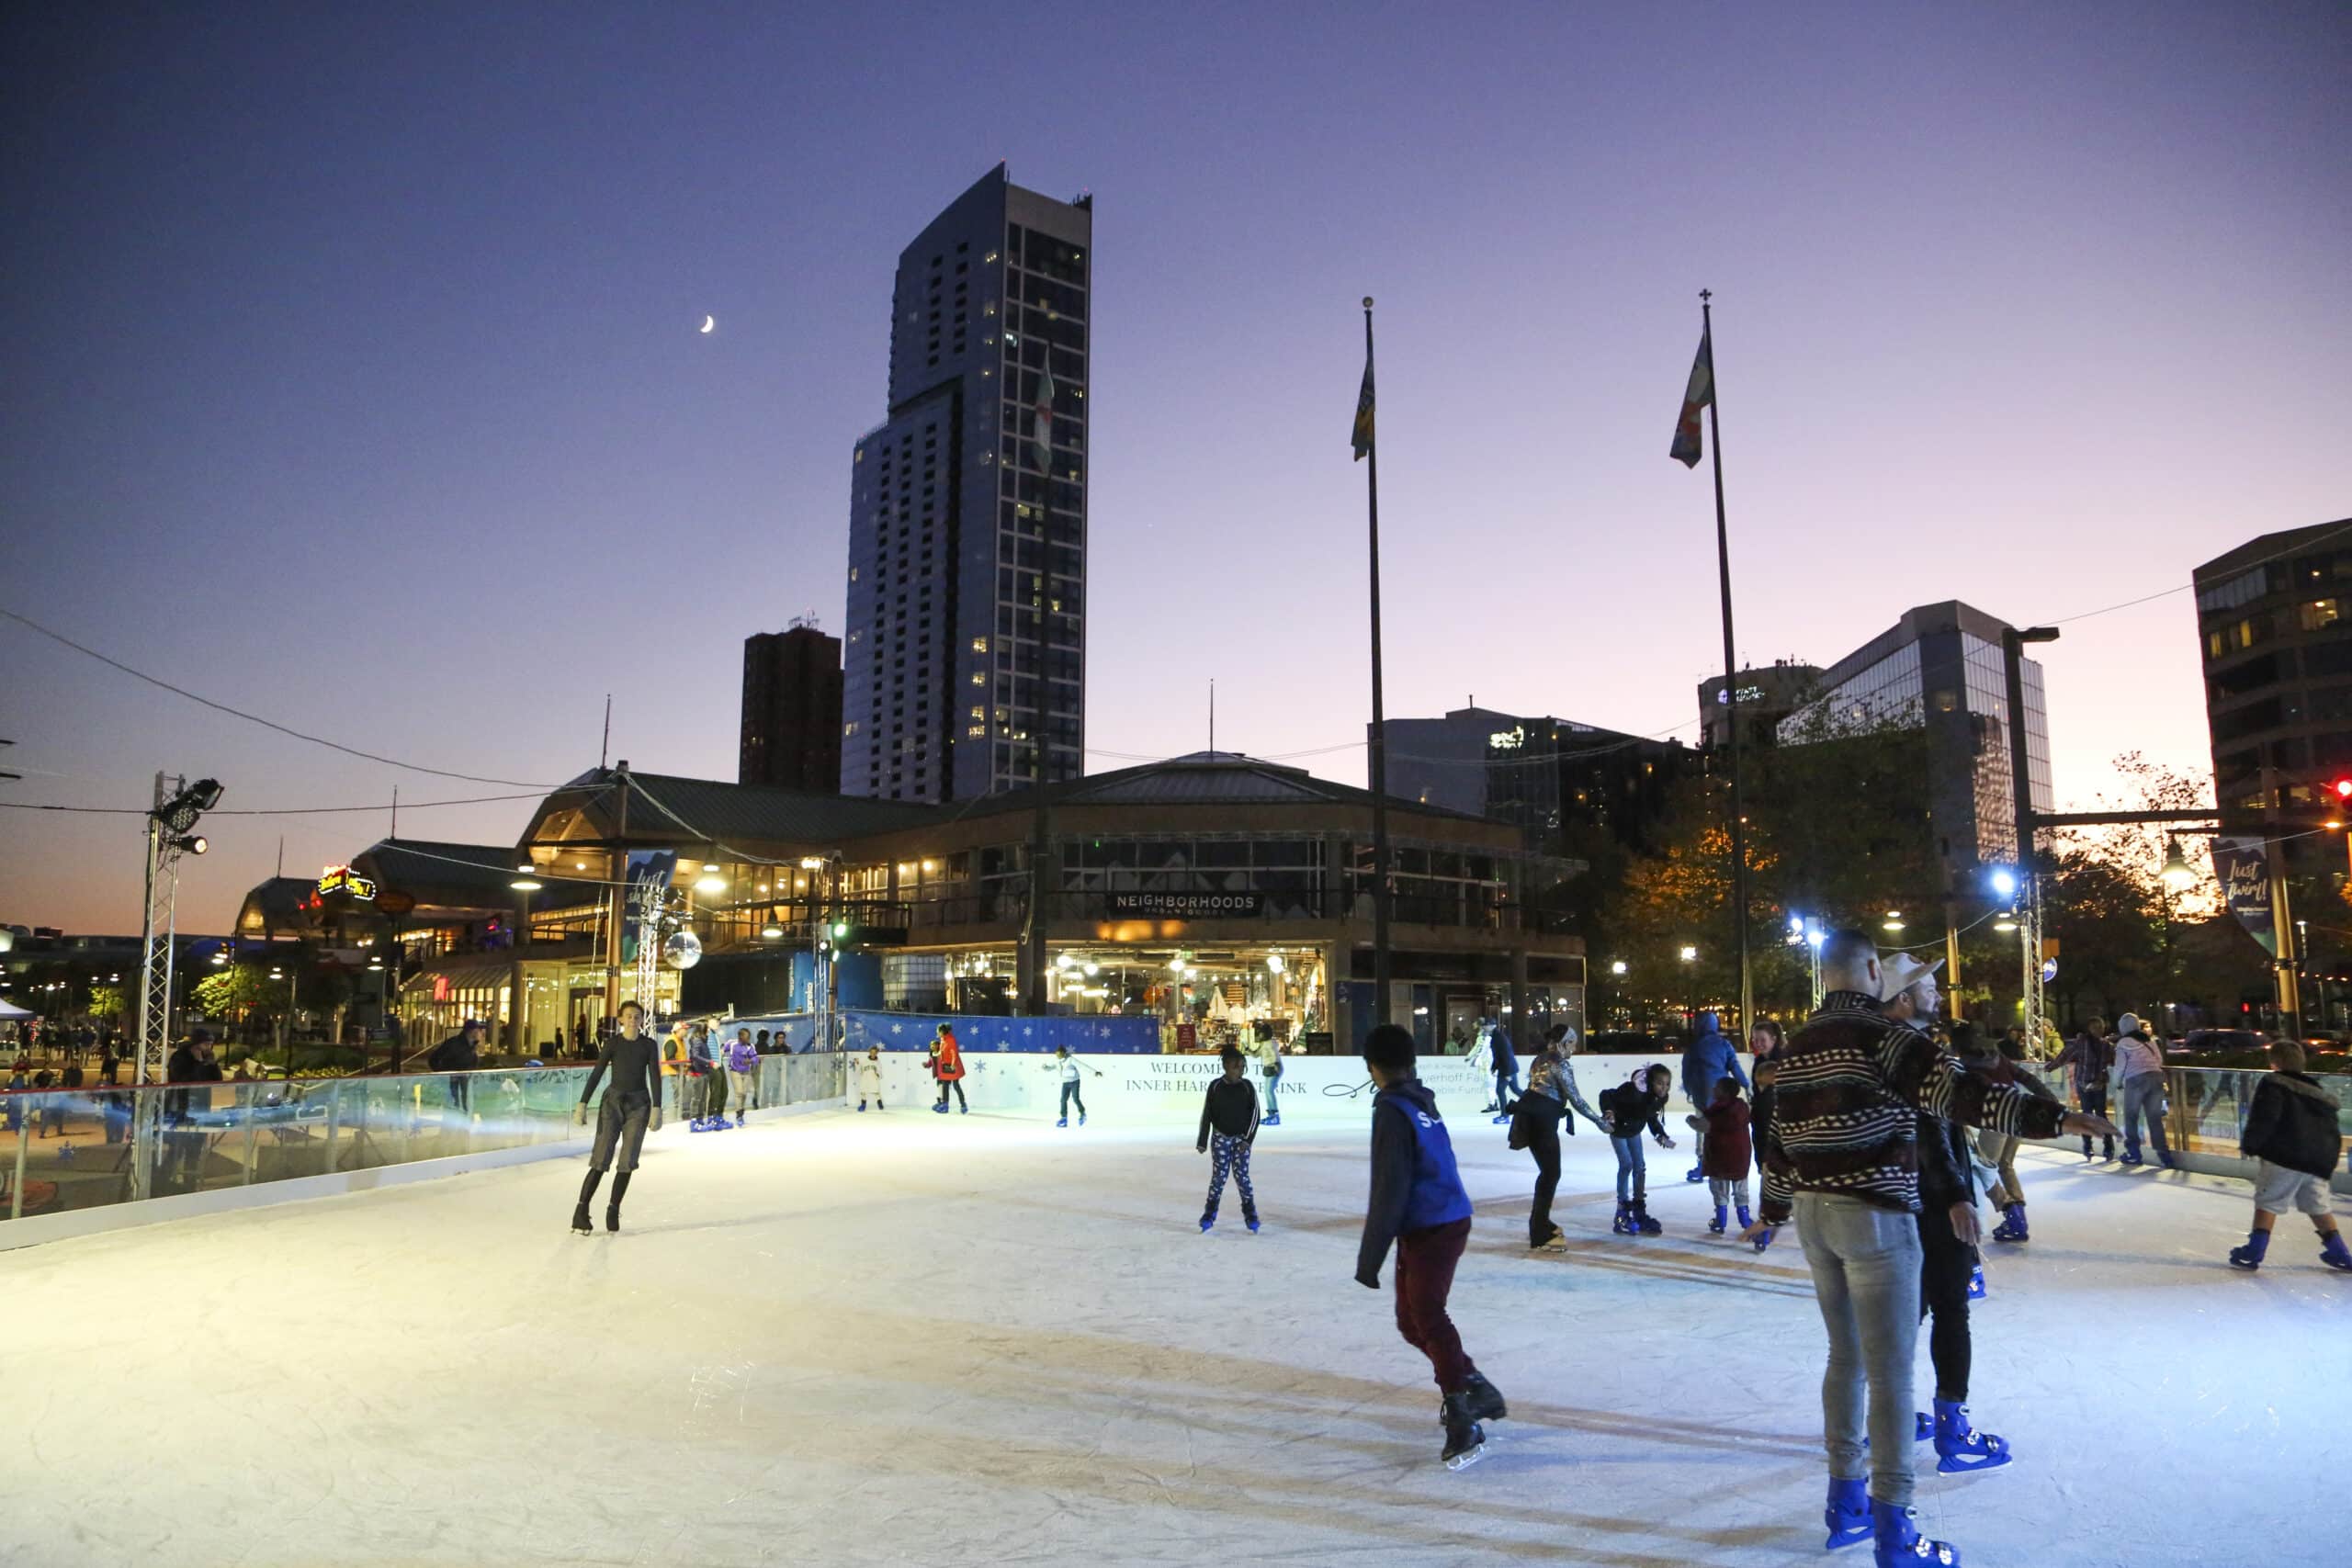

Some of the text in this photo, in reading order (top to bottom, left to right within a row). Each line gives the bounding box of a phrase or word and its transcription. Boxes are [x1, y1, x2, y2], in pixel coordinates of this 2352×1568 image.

[2227, 859, 2262, 882] Just
[2227, 878, 2267, 901] twirl!
[1117, 894, 1255, 908] NEIGHBORHOODS
[1151, 1062, 1223, 1075] WELCOME
[1126, 1079, 1171, 1091] INNER
